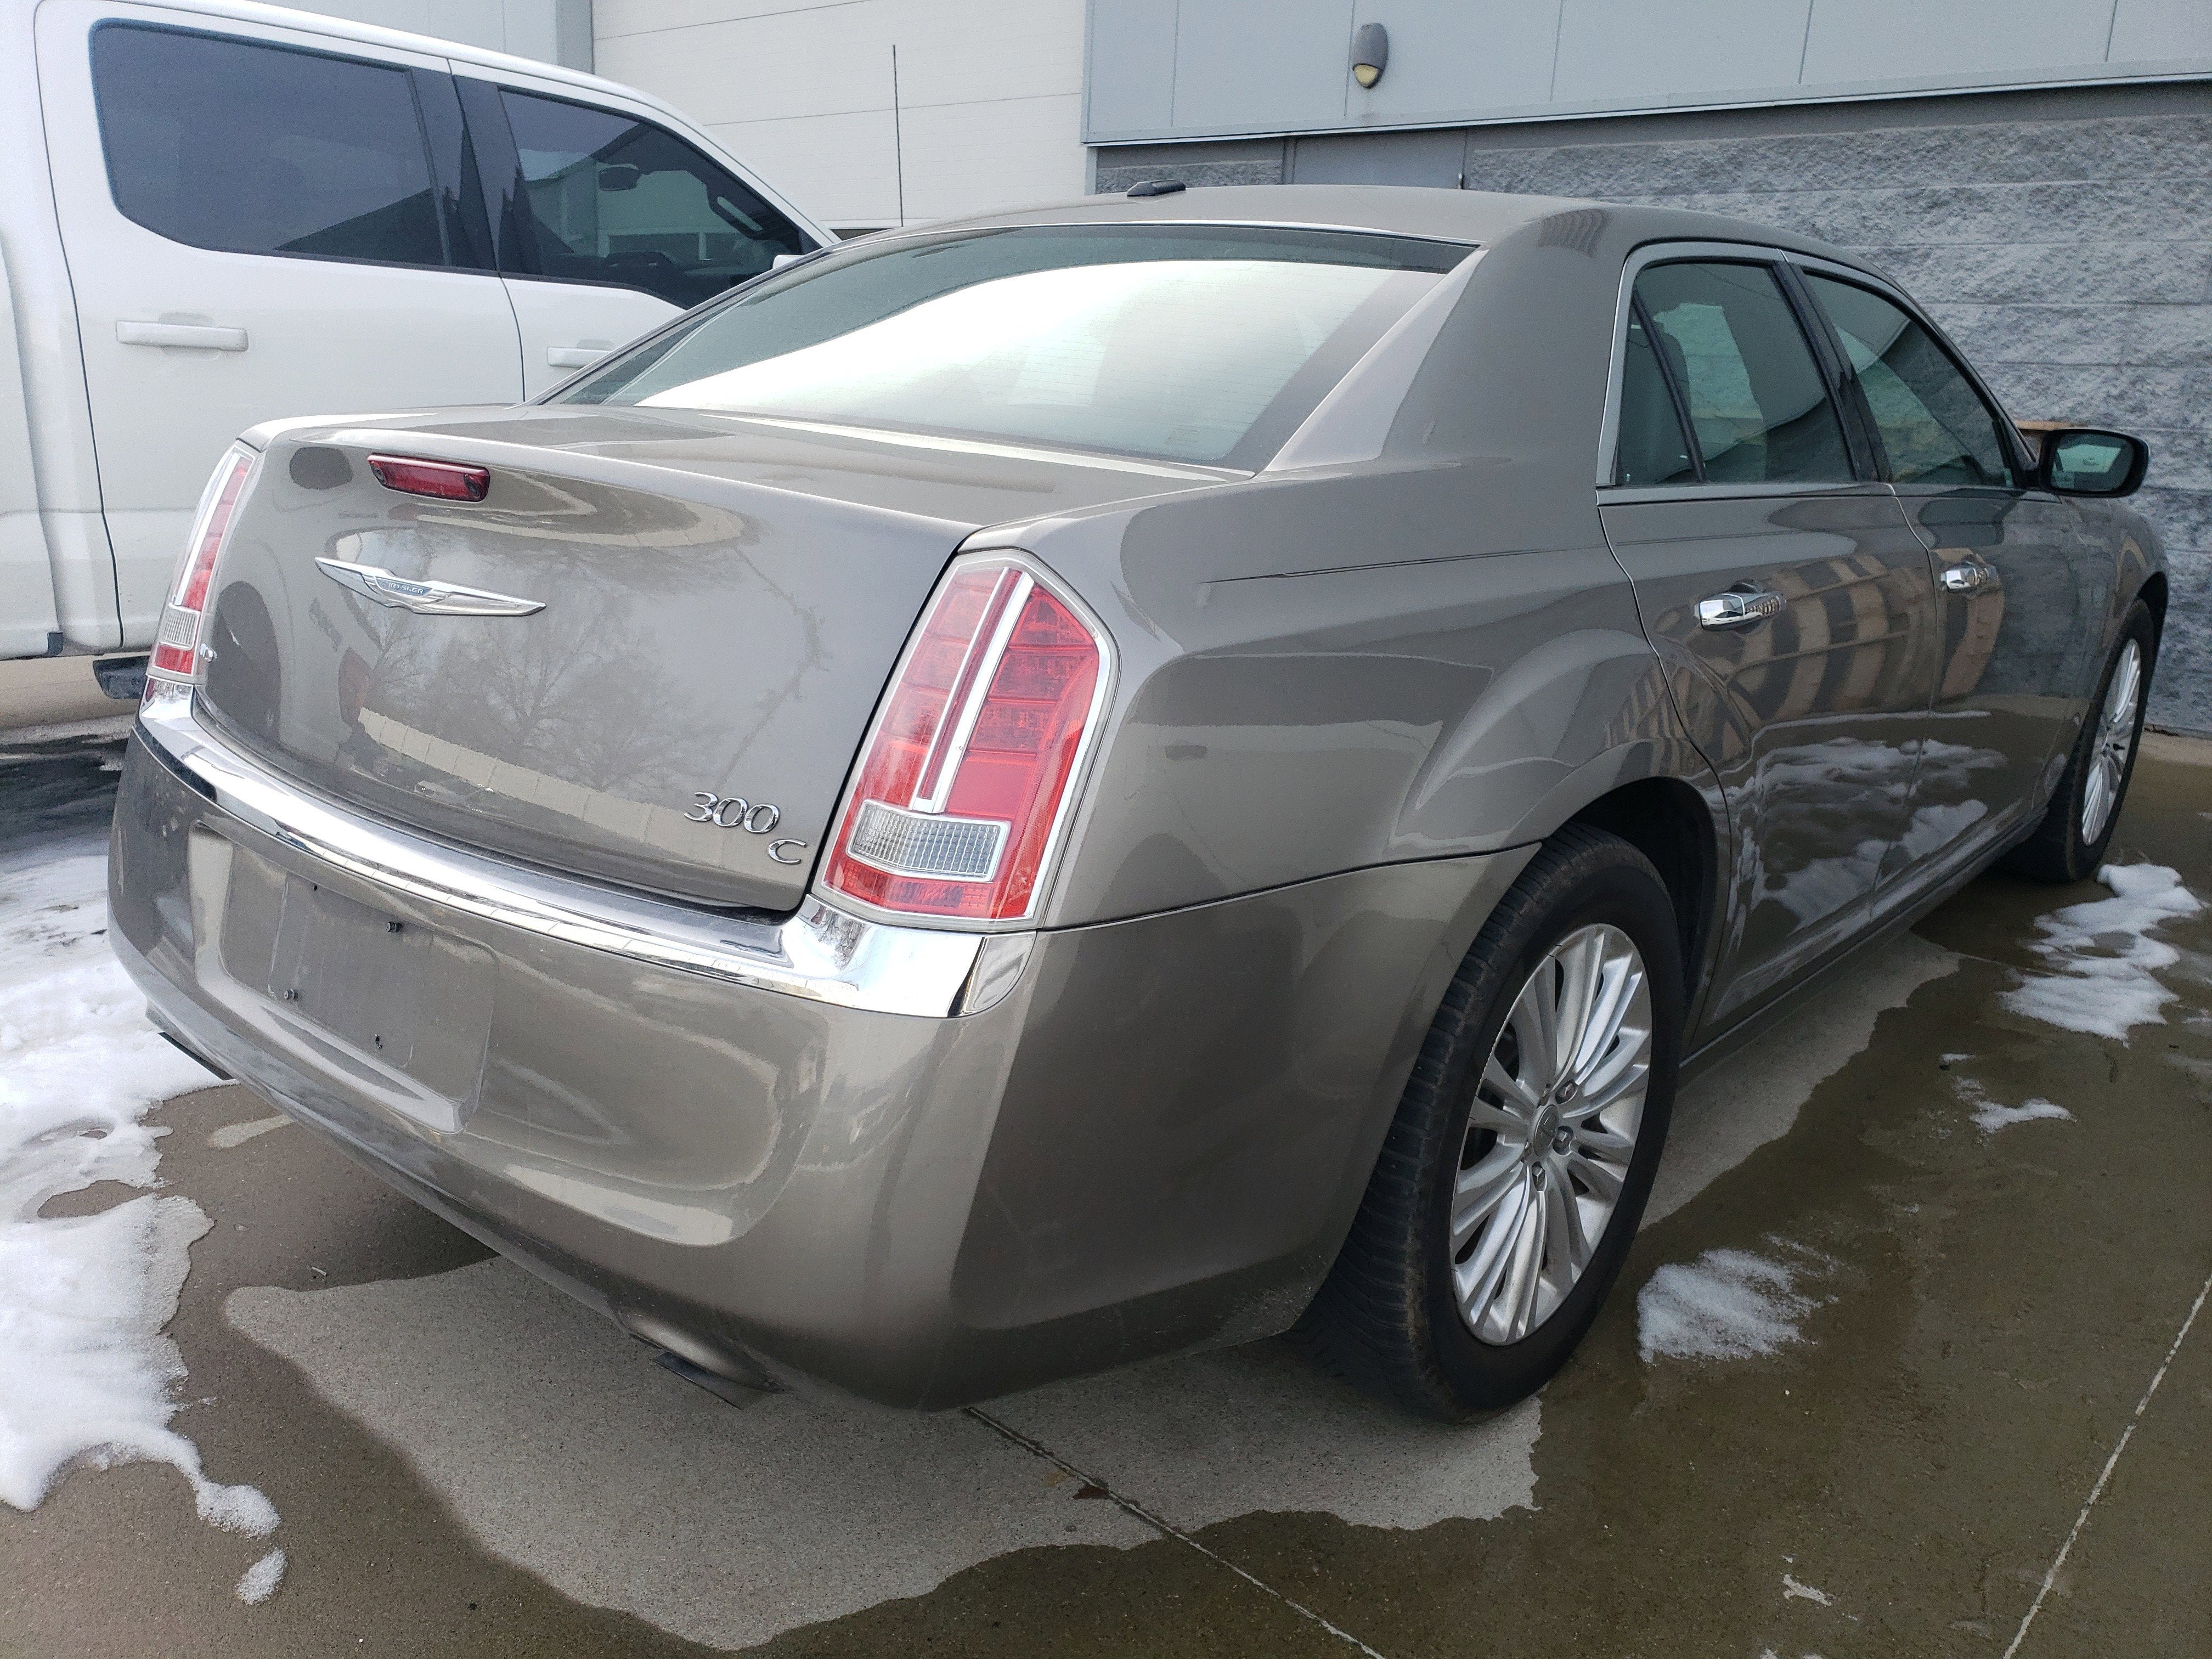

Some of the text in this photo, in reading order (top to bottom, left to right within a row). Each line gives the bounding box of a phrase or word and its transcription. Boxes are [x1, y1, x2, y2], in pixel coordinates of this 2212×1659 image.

[382, 580, 424, 595] RSLER
[684, 792, 780, 834] 300
[768, 838, 807, 865] C
